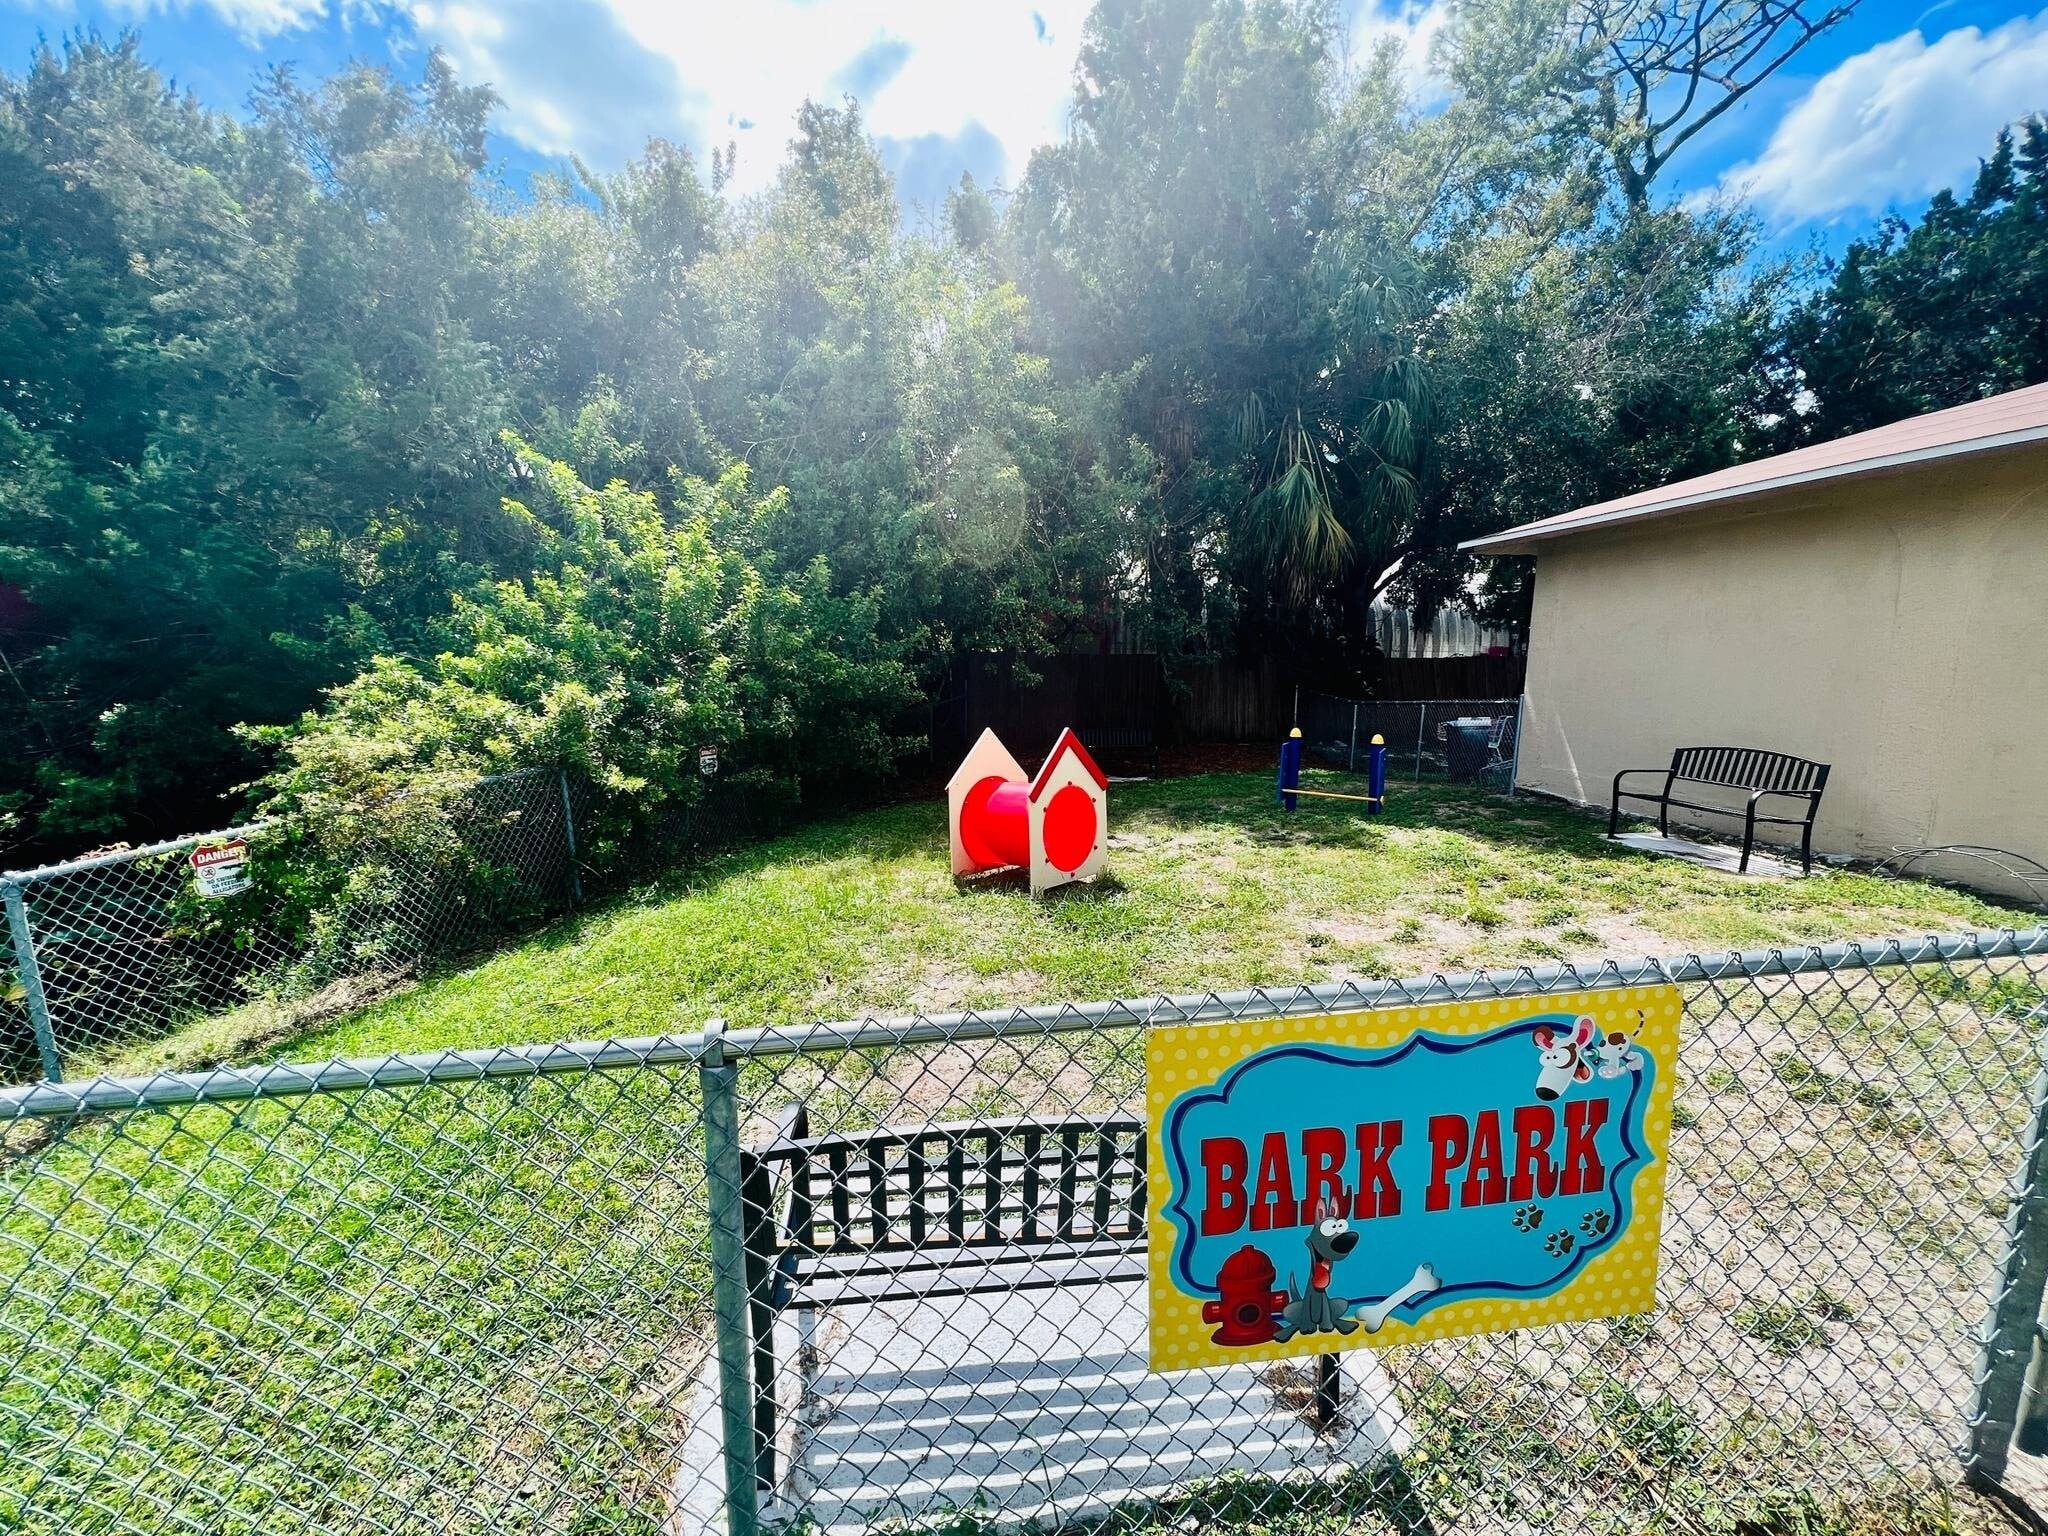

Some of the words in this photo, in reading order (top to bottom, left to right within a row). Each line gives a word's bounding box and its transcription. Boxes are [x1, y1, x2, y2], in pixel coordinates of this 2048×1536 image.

[213, 882, 246, 894] ALLIGATORS
[1200, 1119, 1403, 1237] BARK
[1425, 1097, 1610, 1212] PARK
